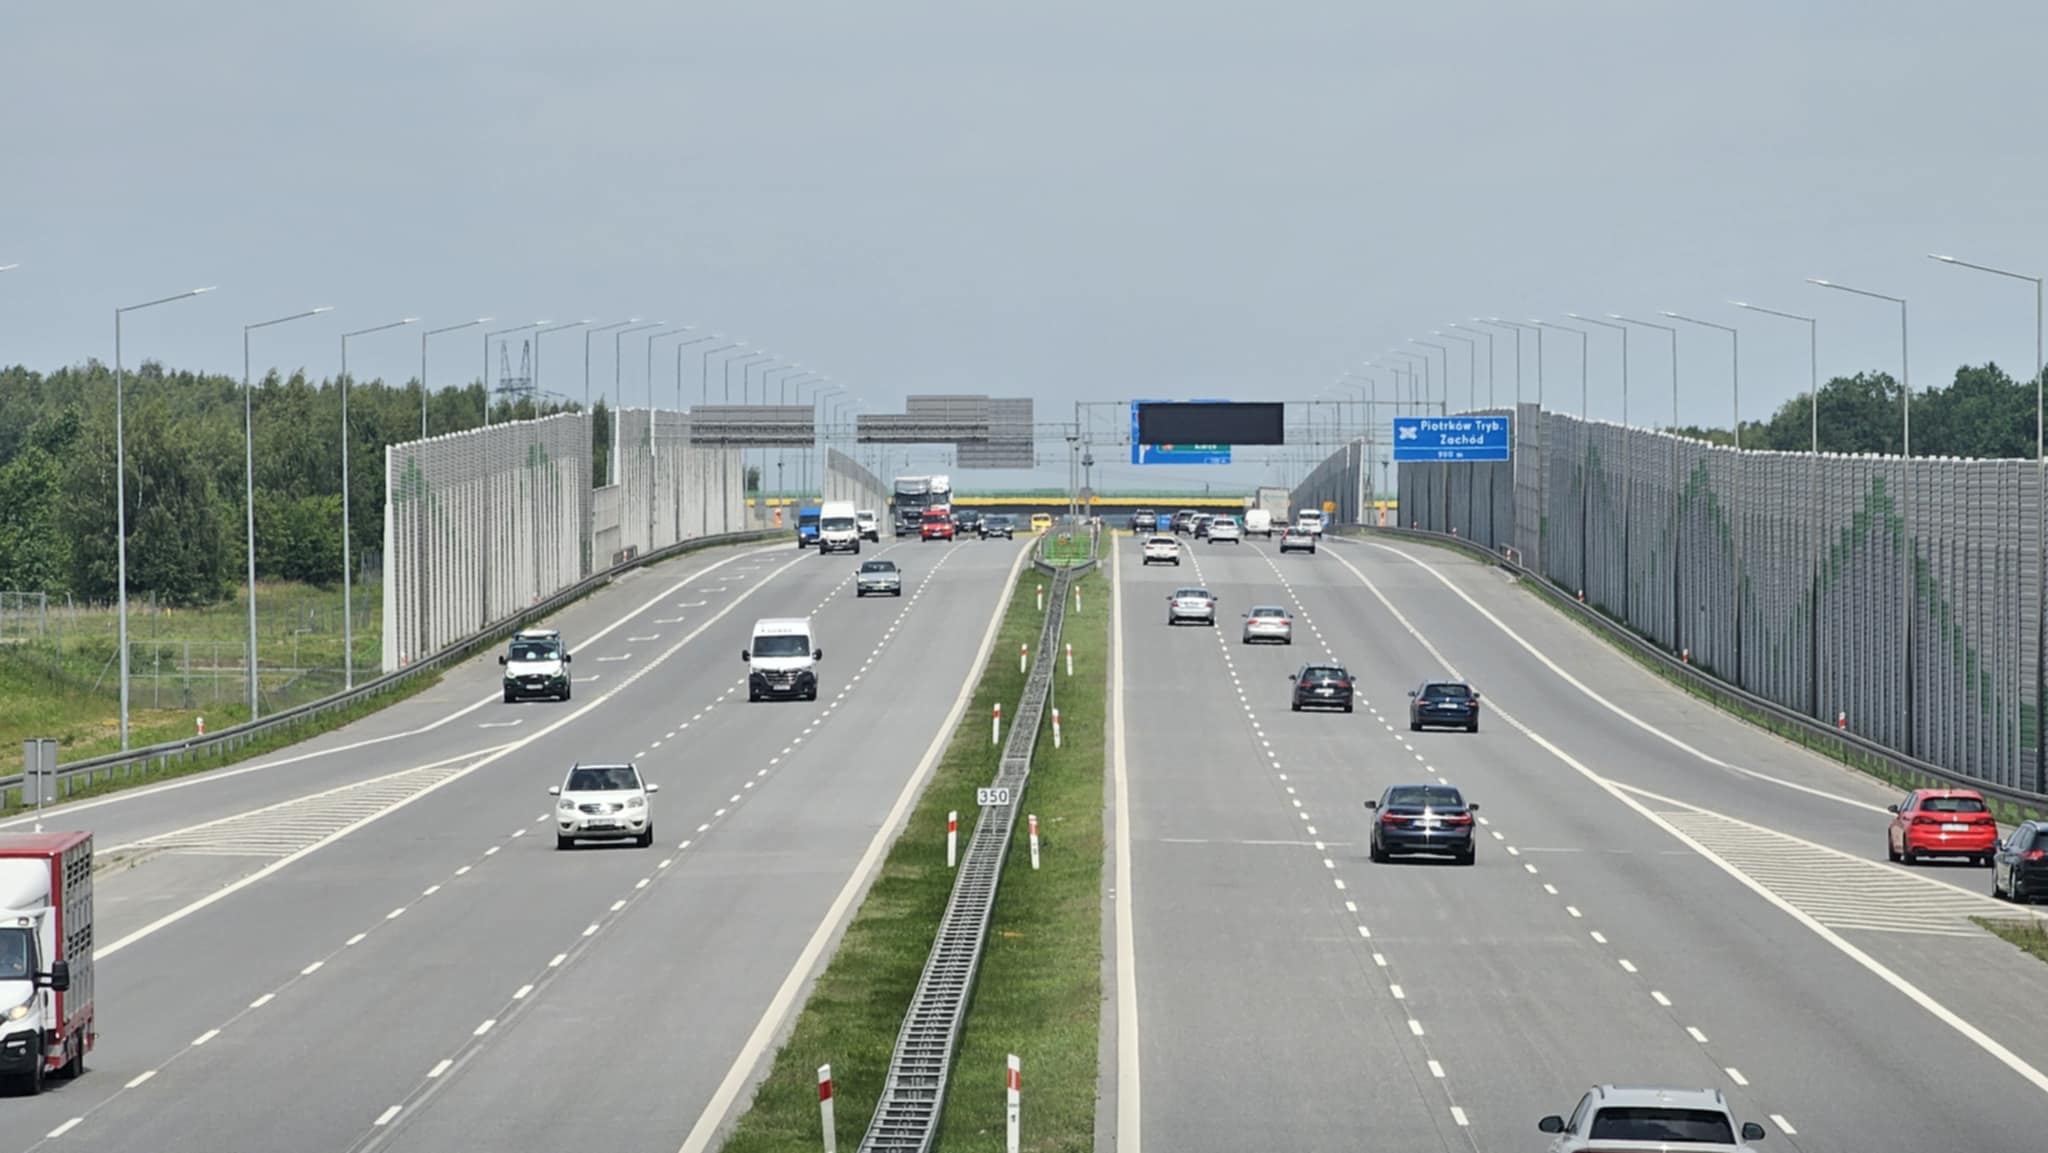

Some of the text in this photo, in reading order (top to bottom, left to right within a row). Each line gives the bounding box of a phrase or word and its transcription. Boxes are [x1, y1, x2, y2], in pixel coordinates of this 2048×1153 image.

[1420, 420, 1503, 433] Piotrków Tryb.
[1440, 433, 1484, 445] Zachód
[980, 790, 1007, 803] 350
